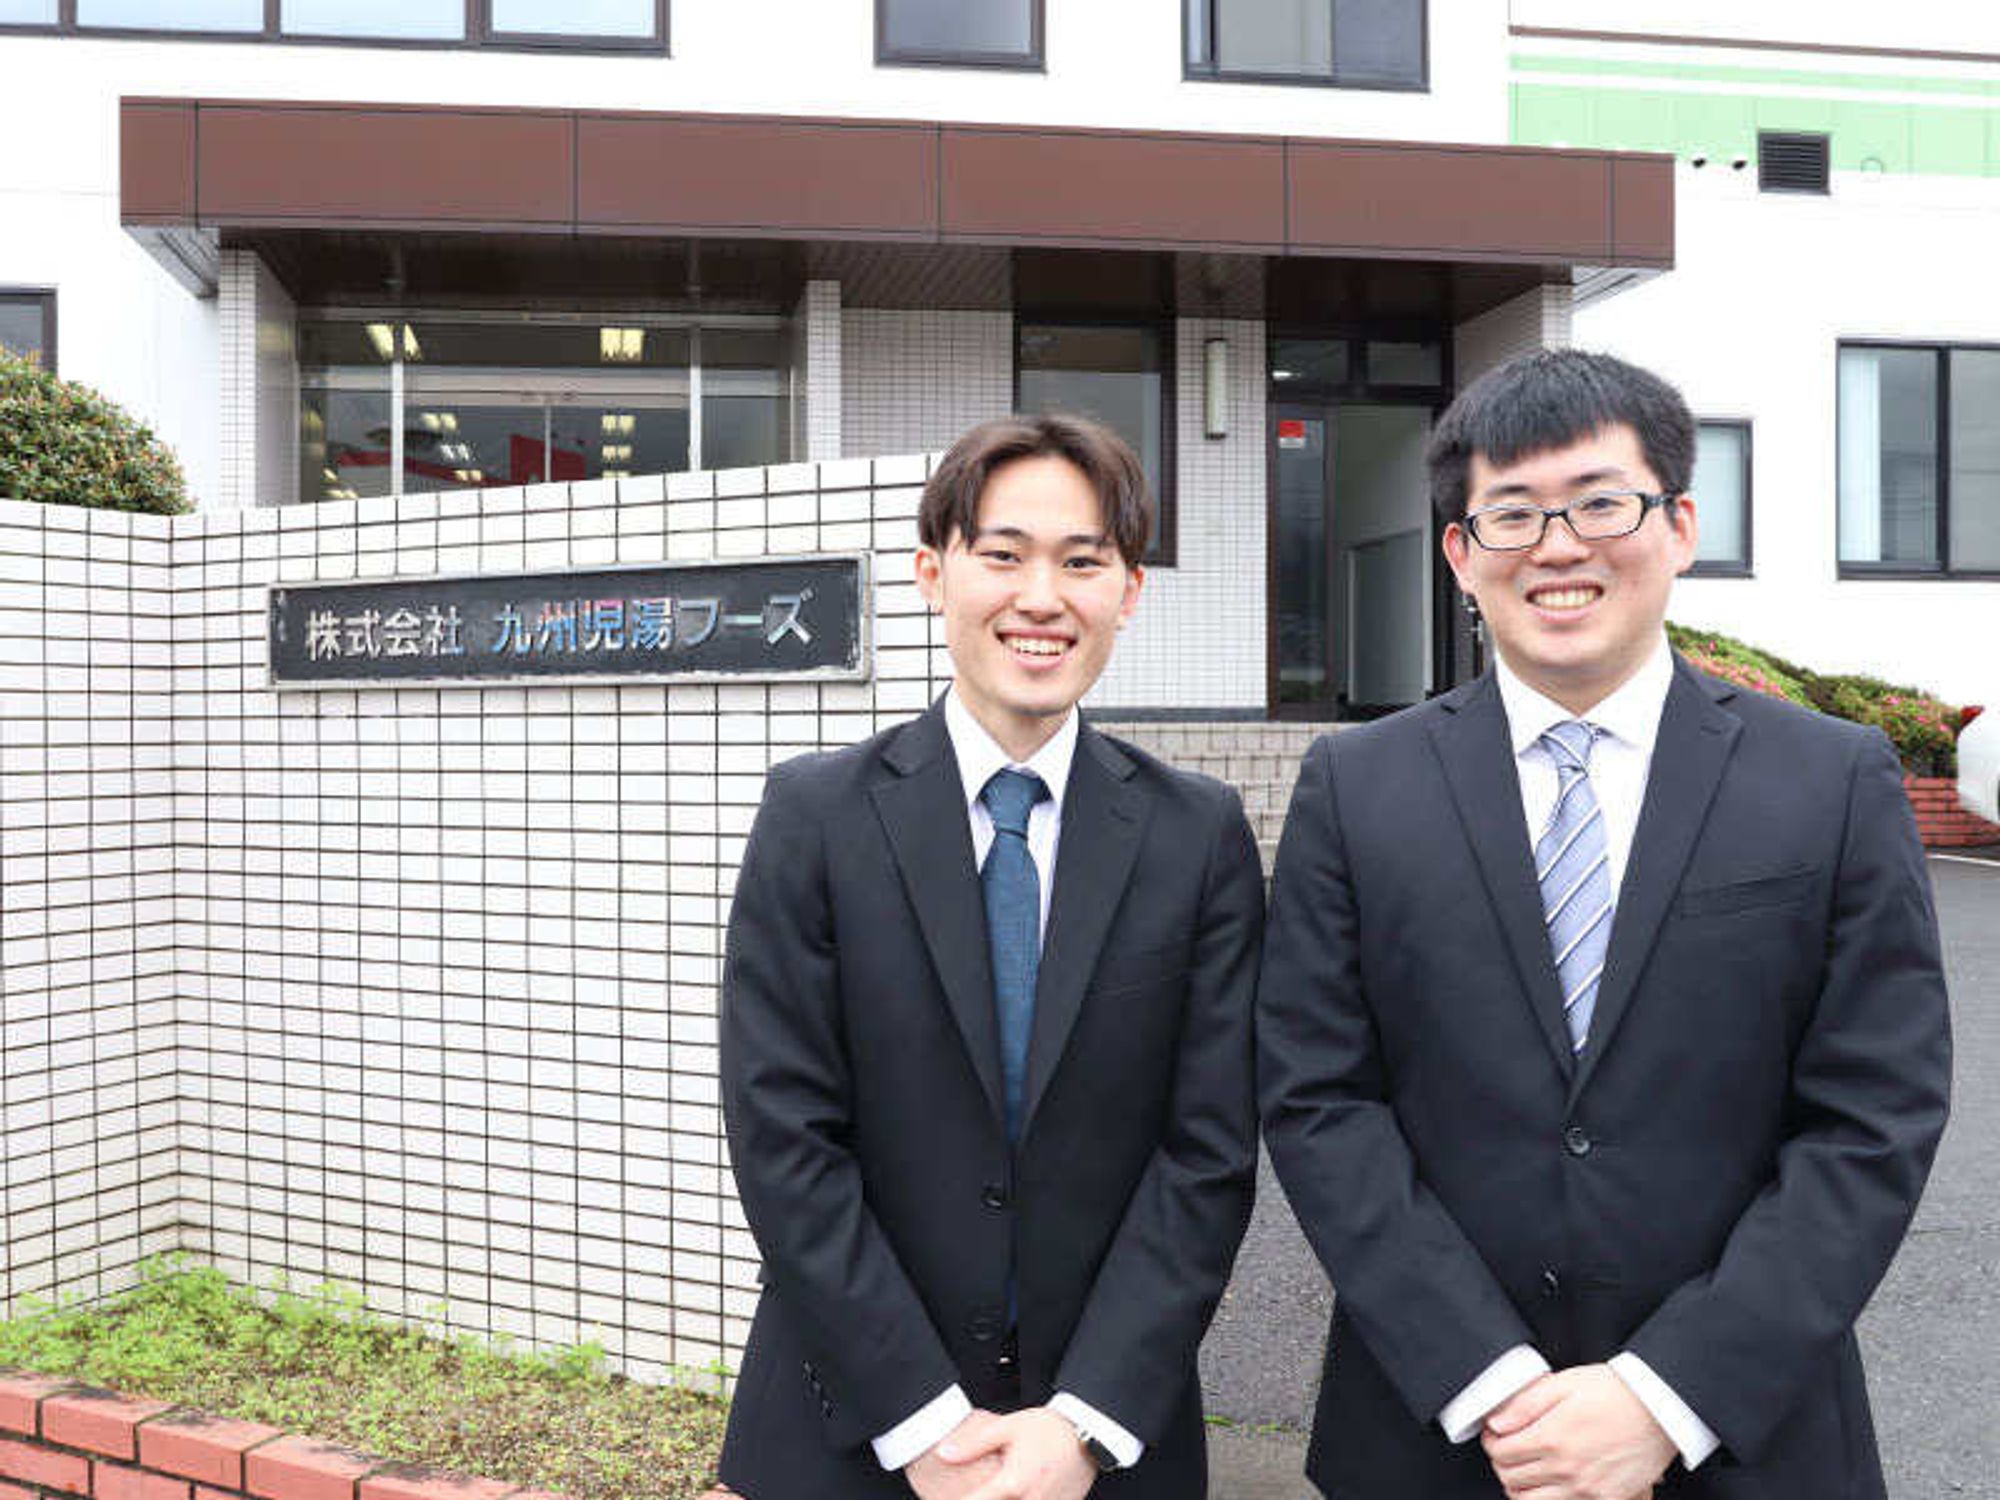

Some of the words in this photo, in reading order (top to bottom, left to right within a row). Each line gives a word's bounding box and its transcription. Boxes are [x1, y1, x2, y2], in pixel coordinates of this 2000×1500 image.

[305, 605, 464, 661] 株式会社
[493, 588, 813, 655] 九州児湯フーズ
